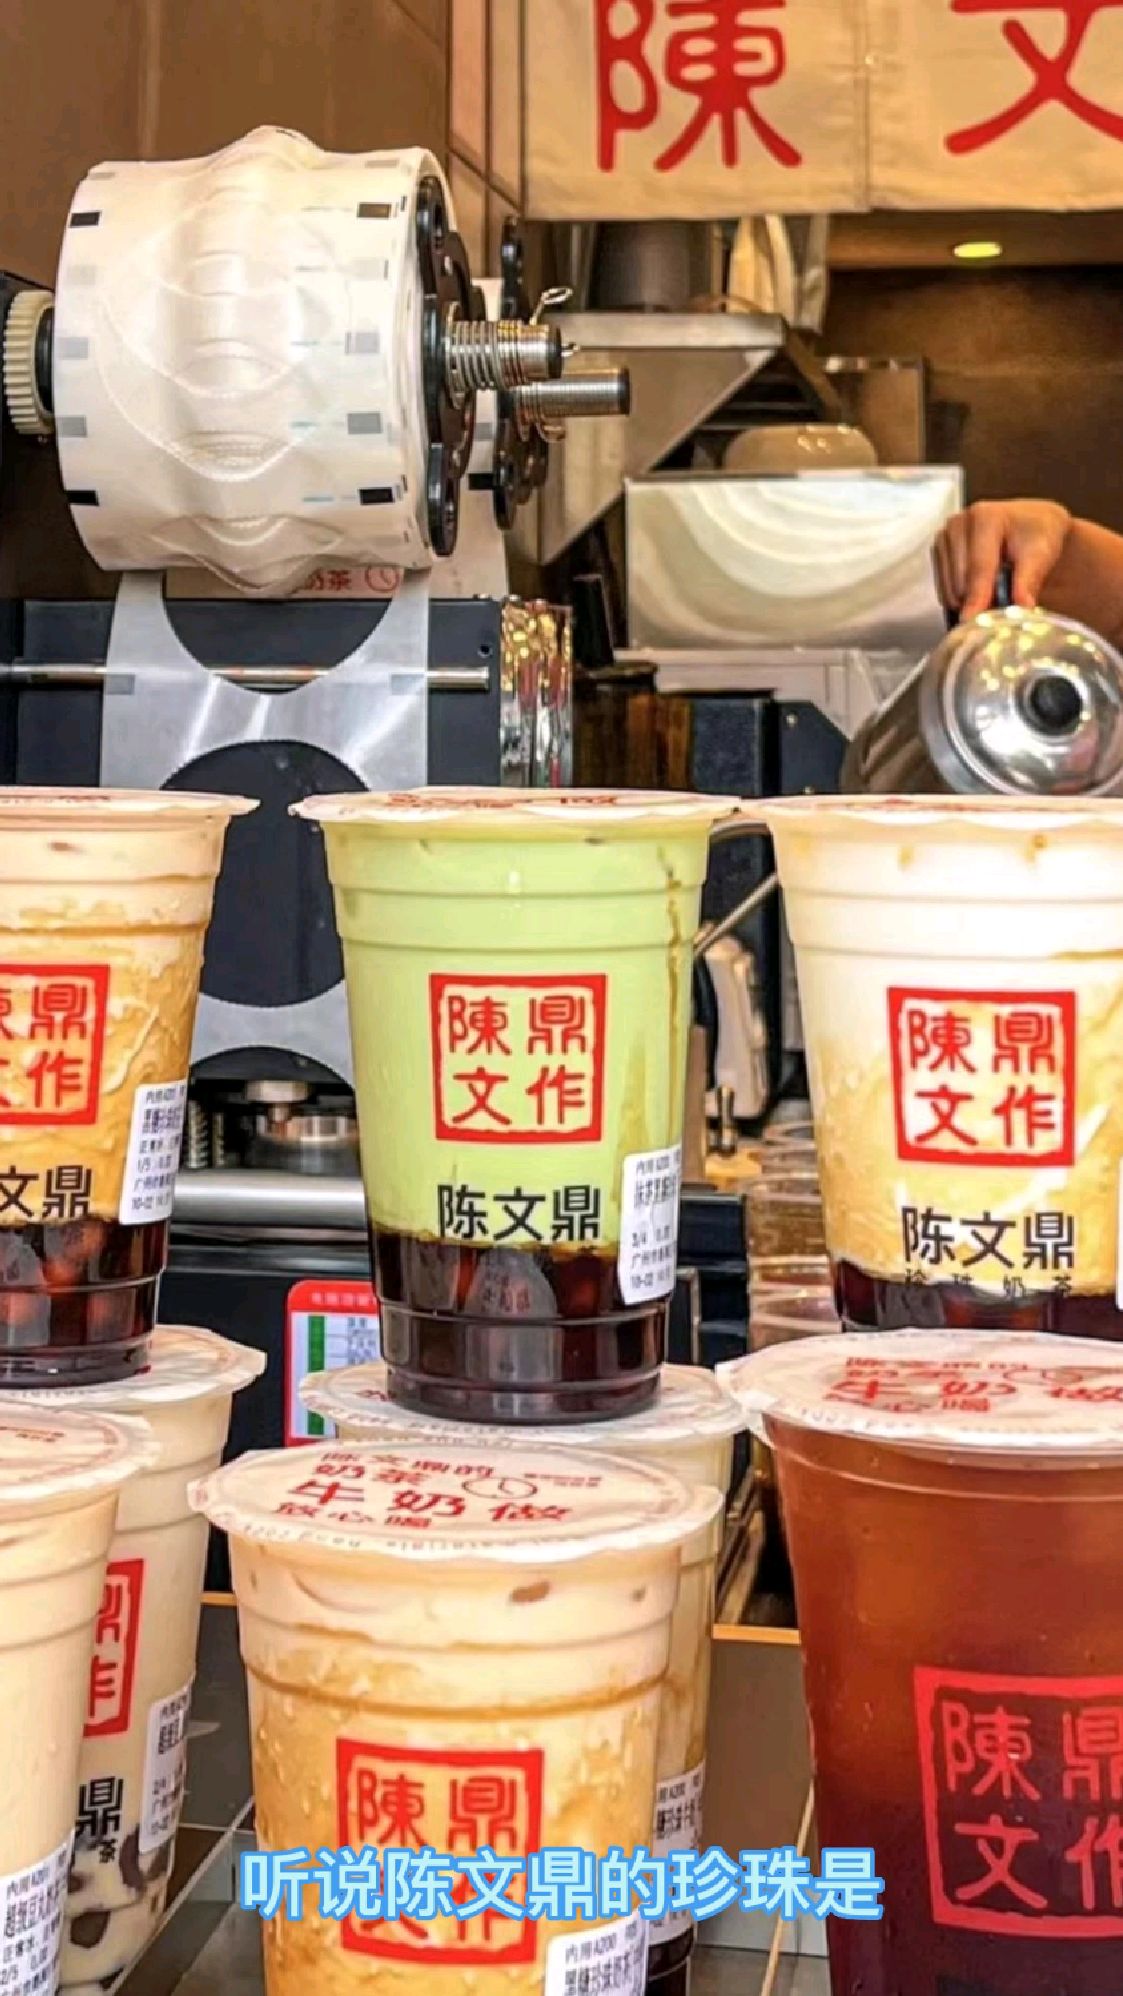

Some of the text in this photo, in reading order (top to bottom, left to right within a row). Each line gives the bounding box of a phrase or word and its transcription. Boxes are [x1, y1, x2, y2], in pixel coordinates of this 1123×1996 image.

[437, 1184, 601, 1242] 陈文鼎
[901, 1205, 1075, 1269] 陈文鼎
[288, 1479, 573, 1523] 牛奶做
